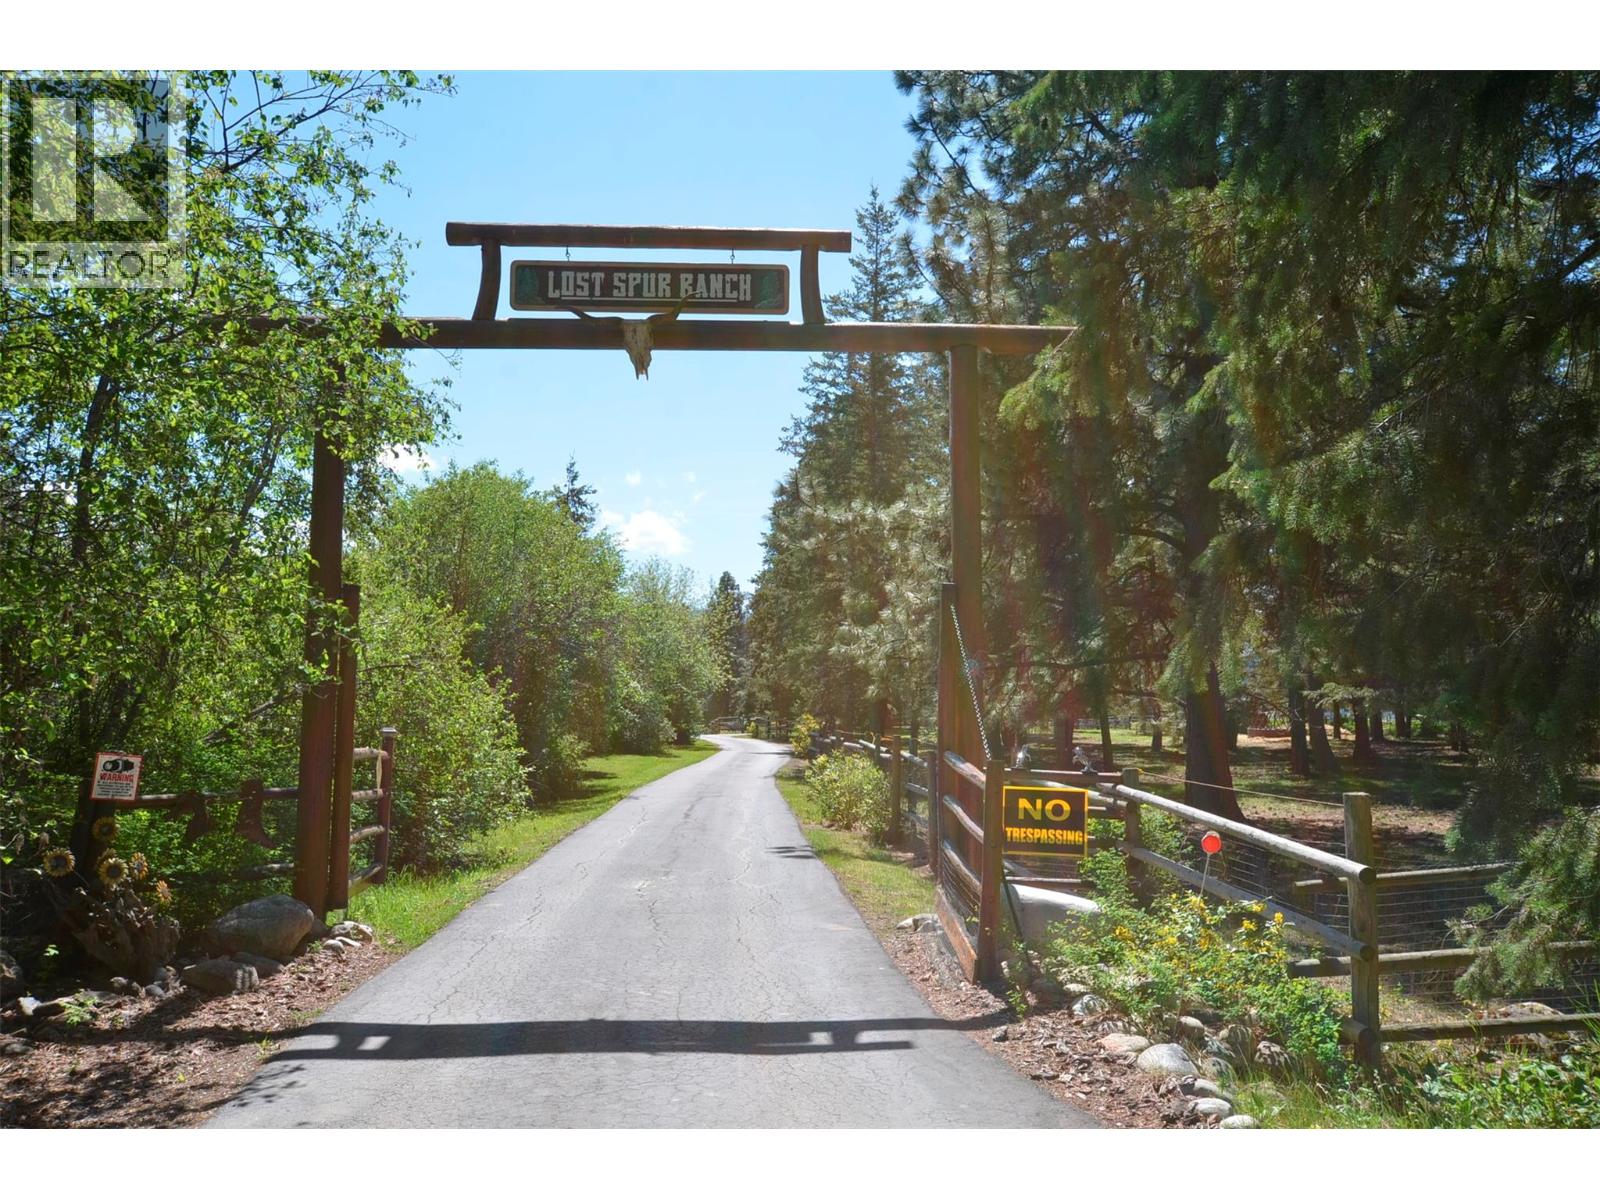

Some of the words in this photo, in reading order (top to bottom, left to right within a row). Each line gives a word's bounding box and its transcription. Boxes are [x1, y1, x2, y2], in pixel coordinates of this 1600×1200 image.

[547, 270, 605, 298] LOST
[612, 273, 671, 298] SPUR
[679, 275, 752, 301] RANCH
[100, 772, 134, 782] WARNING
[1018, 798, 1071, 821] NO
[1005, 827, 1083, 845] TRESPASSING
